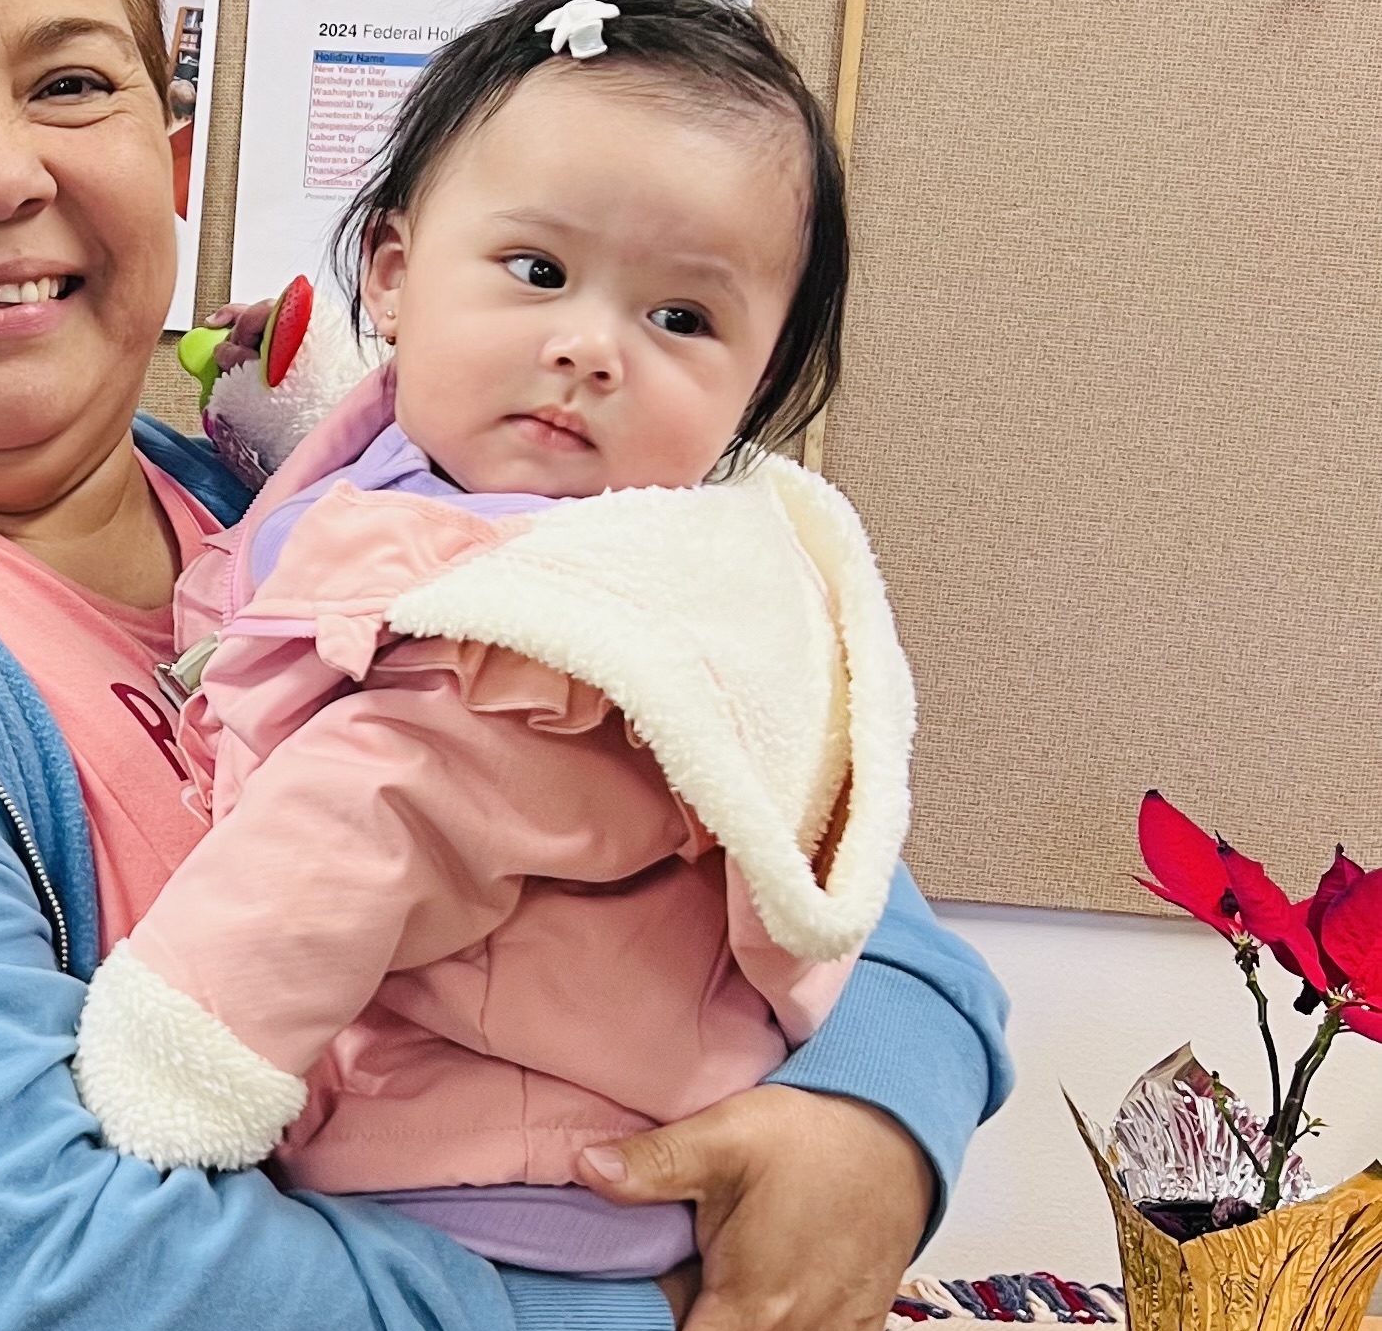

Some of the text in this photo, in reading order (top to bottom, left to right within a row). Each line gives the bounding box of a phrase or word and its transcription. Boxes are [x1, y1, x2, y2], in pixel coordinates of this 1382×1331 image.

[319, 23, 466, 41] 2024 Federal Holi
[315, 52, 386, 64] Holiday Name
[314, 65, 387, 77] New Year's Day
[314, 76, 352, 87] Birthday
[355, 77, 365, 86] of
[367, 78, 396, 87] Martin
[313, 87, 375, 99] Washington's
[312, 99, 375, 110] Memorial Day
[310, 110, 362, 119] Juneteenth
[309, 122, 375, 132] Independence
[309, 133, 356, 143] Labor Day
[308, 143, 356, 153] Columbus
[307, 155, 348, 164] Veterans
